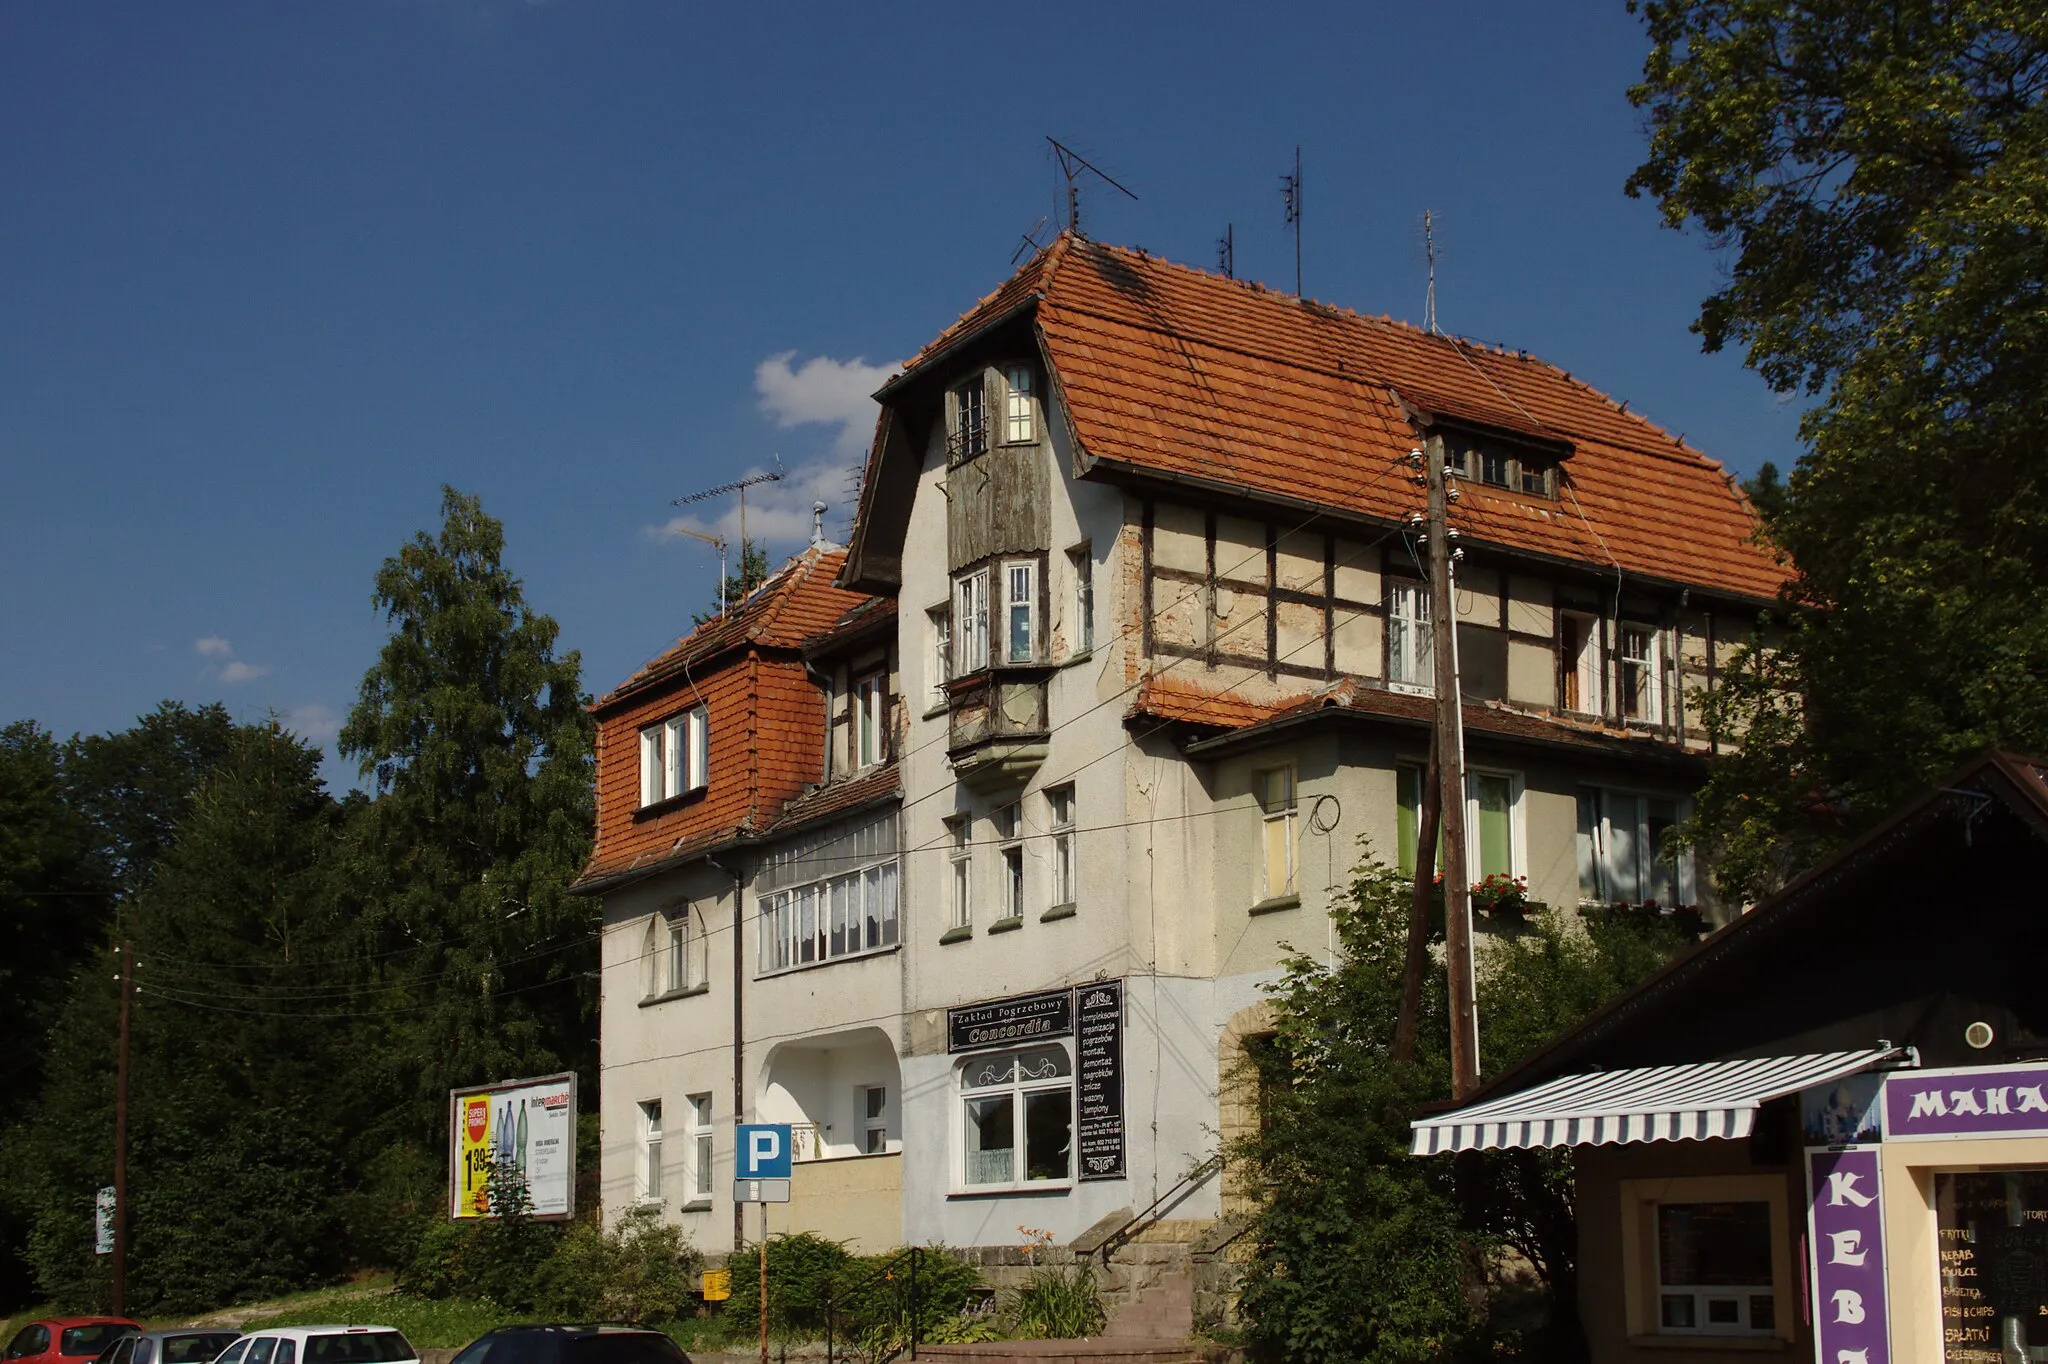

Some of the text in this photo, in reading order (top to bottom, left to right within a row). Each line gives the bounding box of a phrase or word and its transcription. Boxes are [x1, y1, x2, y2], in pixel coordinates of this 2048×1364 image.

[958, 999, 1063, 1024] Zakład Pogrzebowy
[1083, 1010, 1119, 1024] kompleksowa
[968, 1018, 1051, 1043] Concordia
[1082, 1022, 1115, 1035] organizacja
[1083, 1033, 1113, 1048] pogrzebów
[1083, 1057, 1112, 1068] demontaż
[1083, 1067, 1113, 1081] nagrobków
[1084, 1082, 1101, 1091] znicze
[1084, 1094, 1105, 1103] wazony
[1907, 1084, 2048, 1122] MAHA
[1084, 1104, 1109, 1116] lampiony
[749, 1130, 780, 1172] P
[1939, 1228, 1970, 1241] FRYTKI
[1940, 1249, 1975, 1262] KEBAB
[1941, 1267, 1978, 1278] BUŁCE
[1943, 1306, 1962, 1317] FISH
[1969, 1306, 1996, 1317] CHIPS
